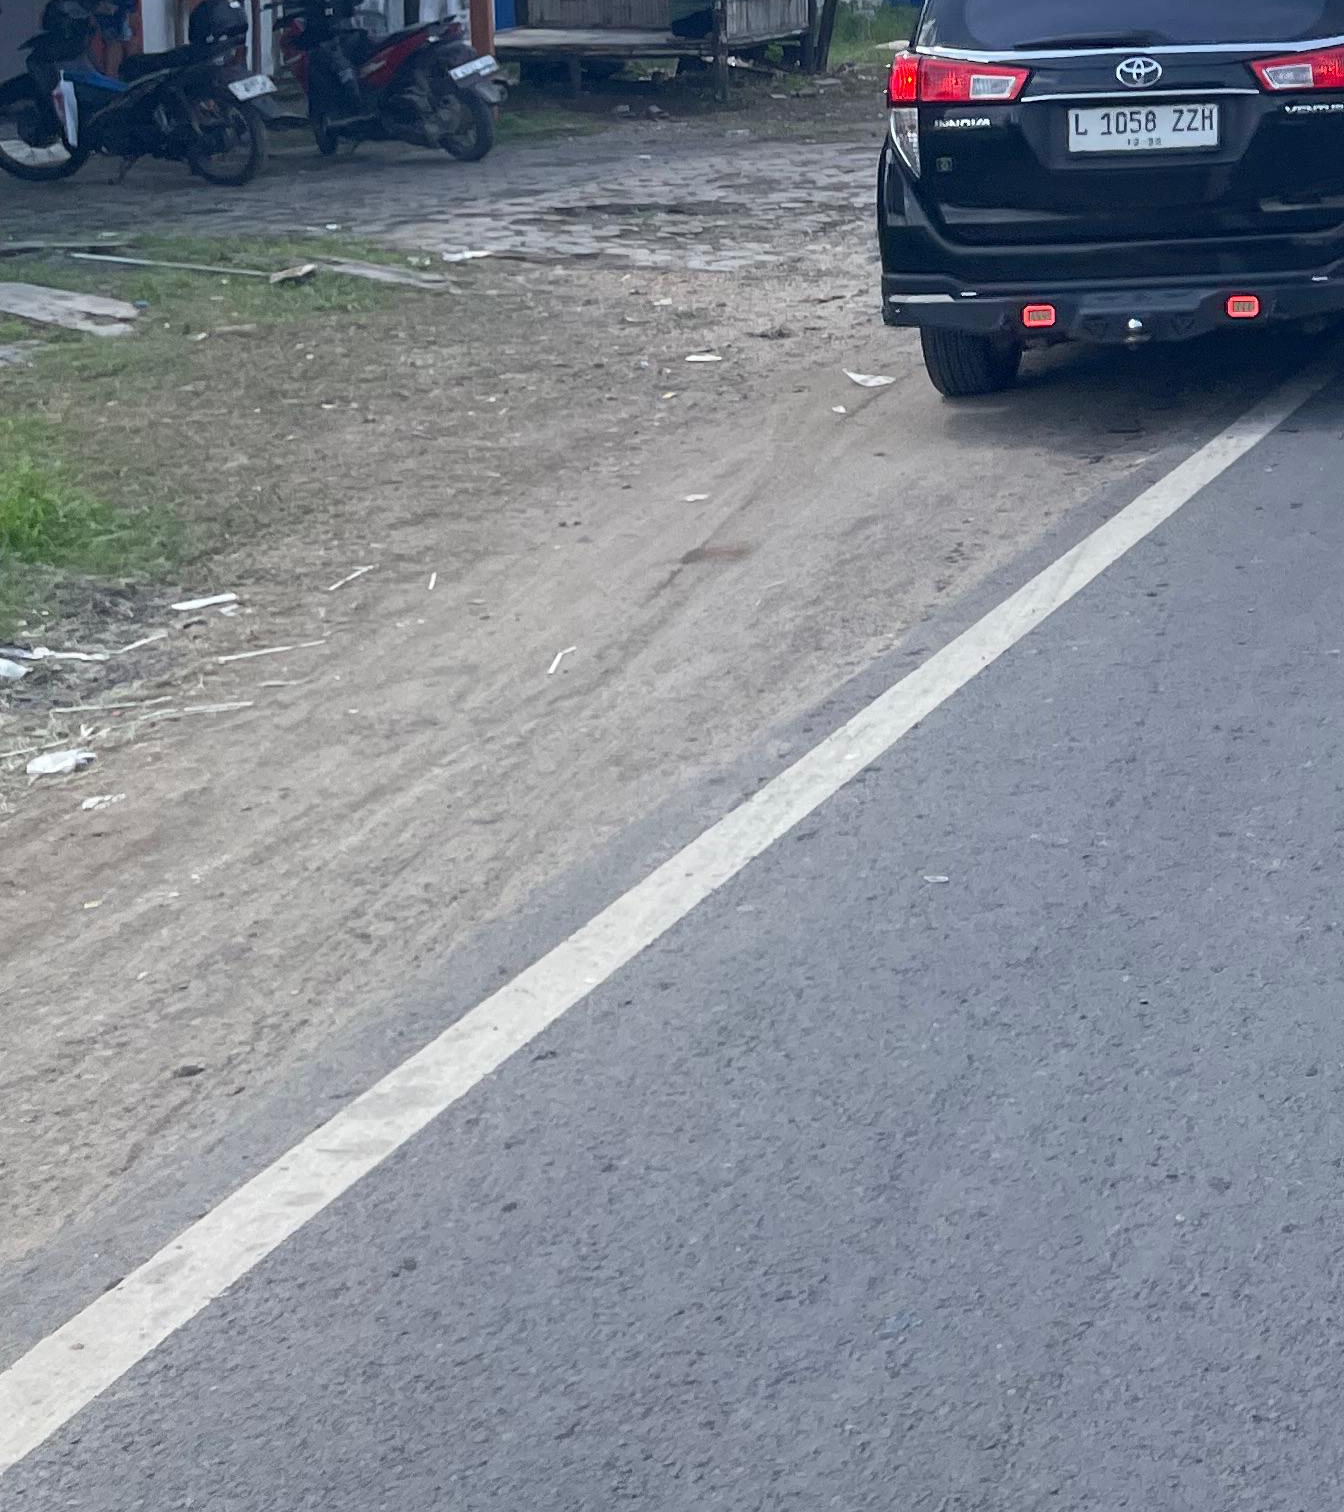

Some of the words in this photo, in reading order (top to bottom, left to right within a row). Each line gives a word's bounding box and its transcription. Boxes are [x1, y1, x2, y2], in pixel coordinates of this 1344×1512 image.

[1074, 113, 1089, 136] L
[1100, 110, 1157, 136] 1058
[1172, 108, 1215, 133] ZZH
